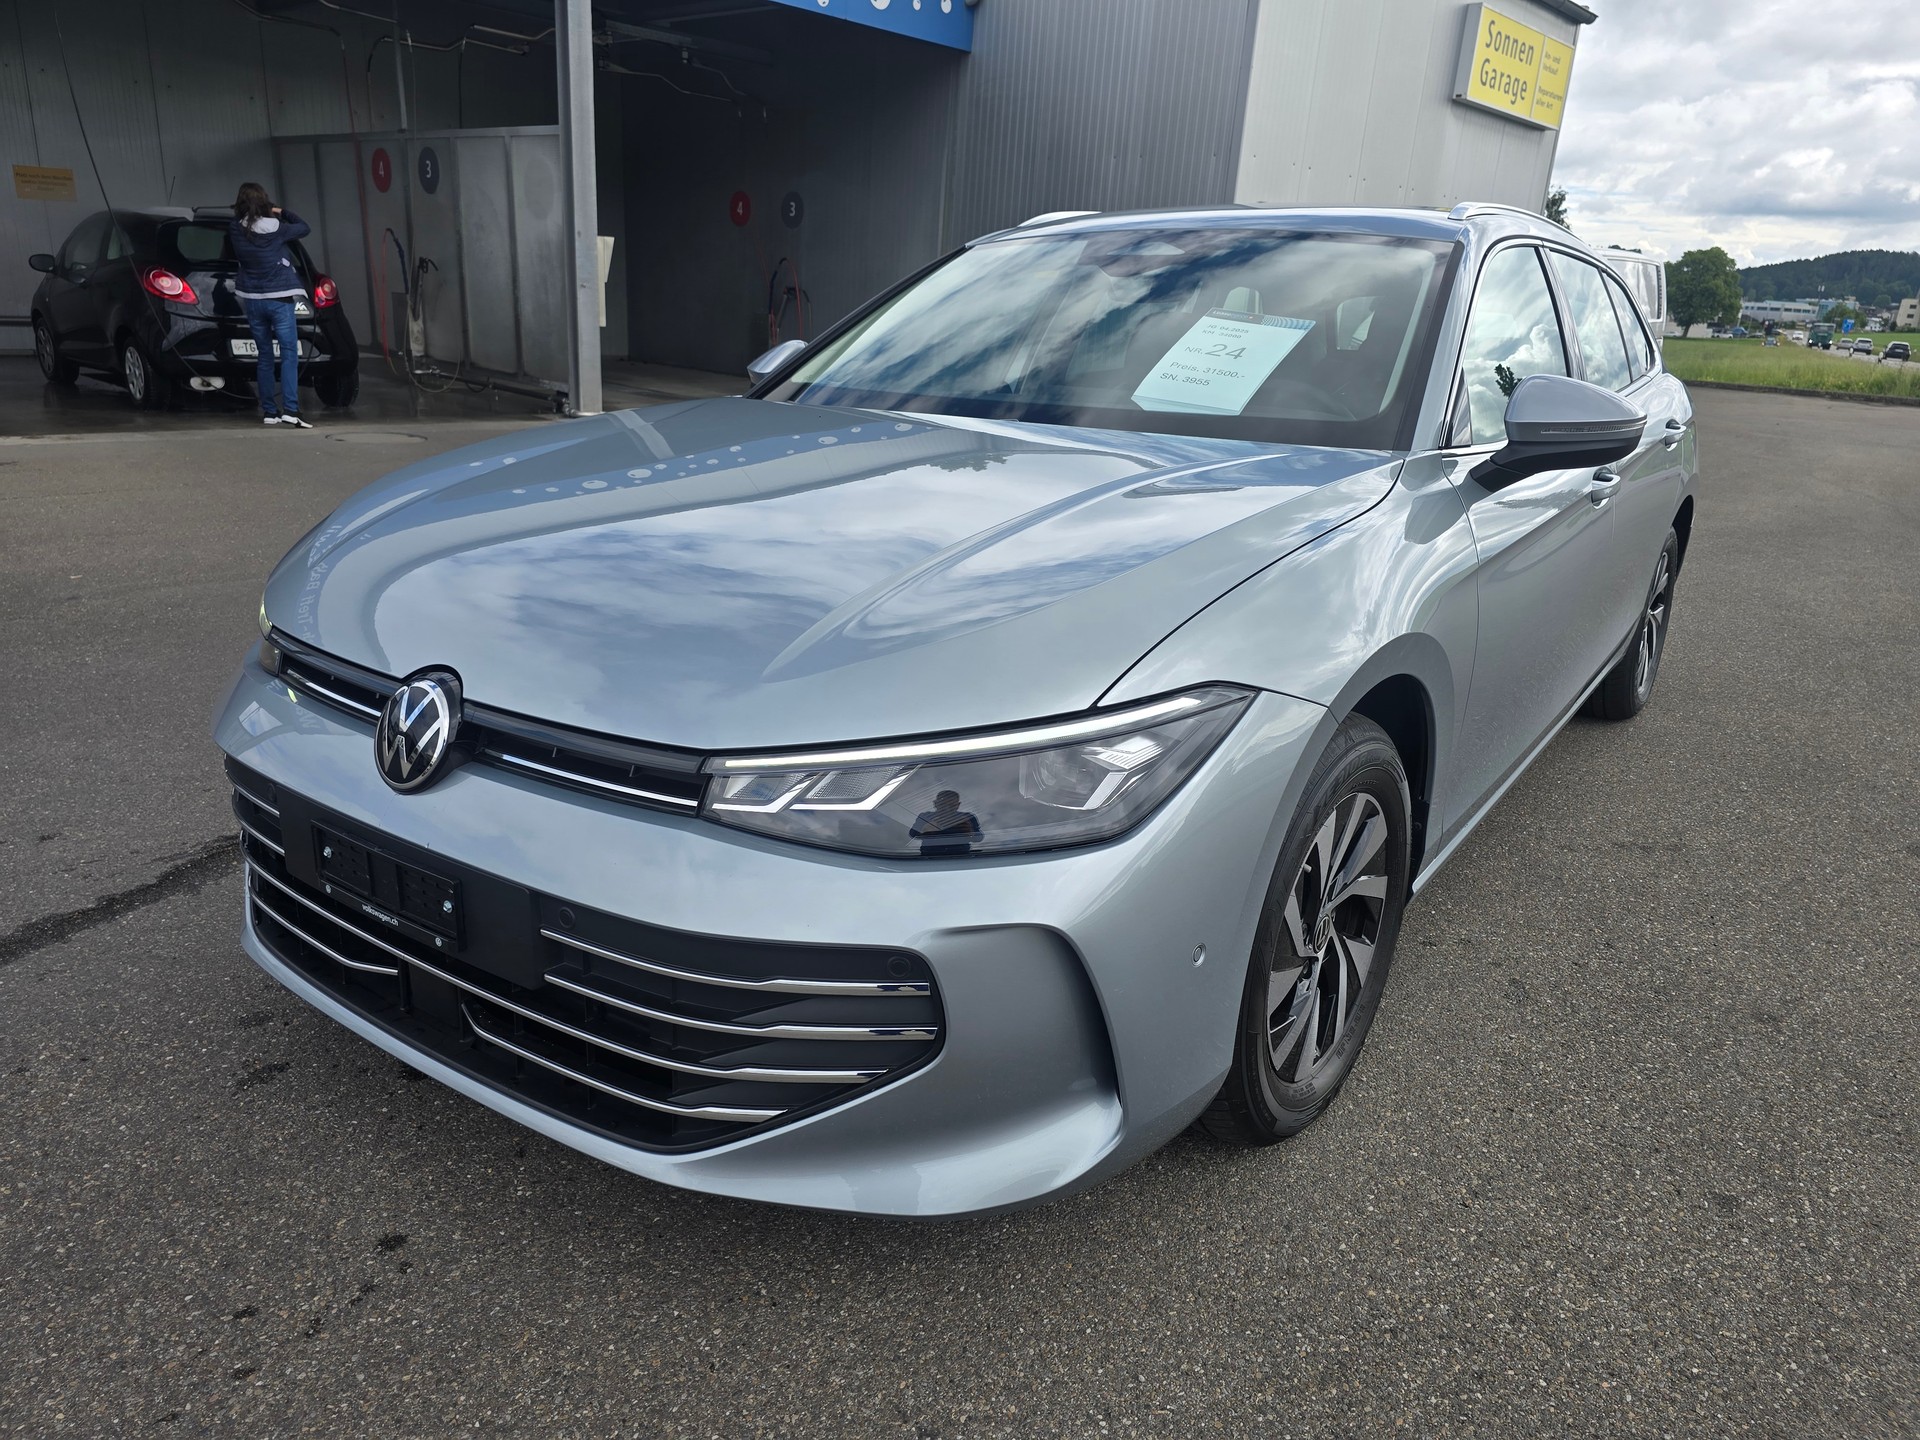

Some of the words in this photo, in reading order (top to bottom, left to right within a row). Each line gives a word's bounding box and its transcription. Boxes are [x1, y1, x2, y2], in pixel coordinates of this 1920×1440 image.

[1485, 20, 1534, 66] Sonnen
[1480, 58, 1527, 105] Garage
[379, 161, 385, 178] 4
[425, 160, 432, 178] 3
[737, 201, 743, 215] 4
[789, 202, 796, 216] 3
[242, 342, 256, 353] TG
[1184, 346, 1203, 355] NR.
[1204, 343, 1247, 360] 24
[1169, 361, 1200, 373] Preis.
[1202, 367, 1246, 378] 31500.-
[1160, 372, 1179, 382] SN.
[1182, 376, 1211, 386] 3955
[362, 903, 399, 927] volkswagen.ch
